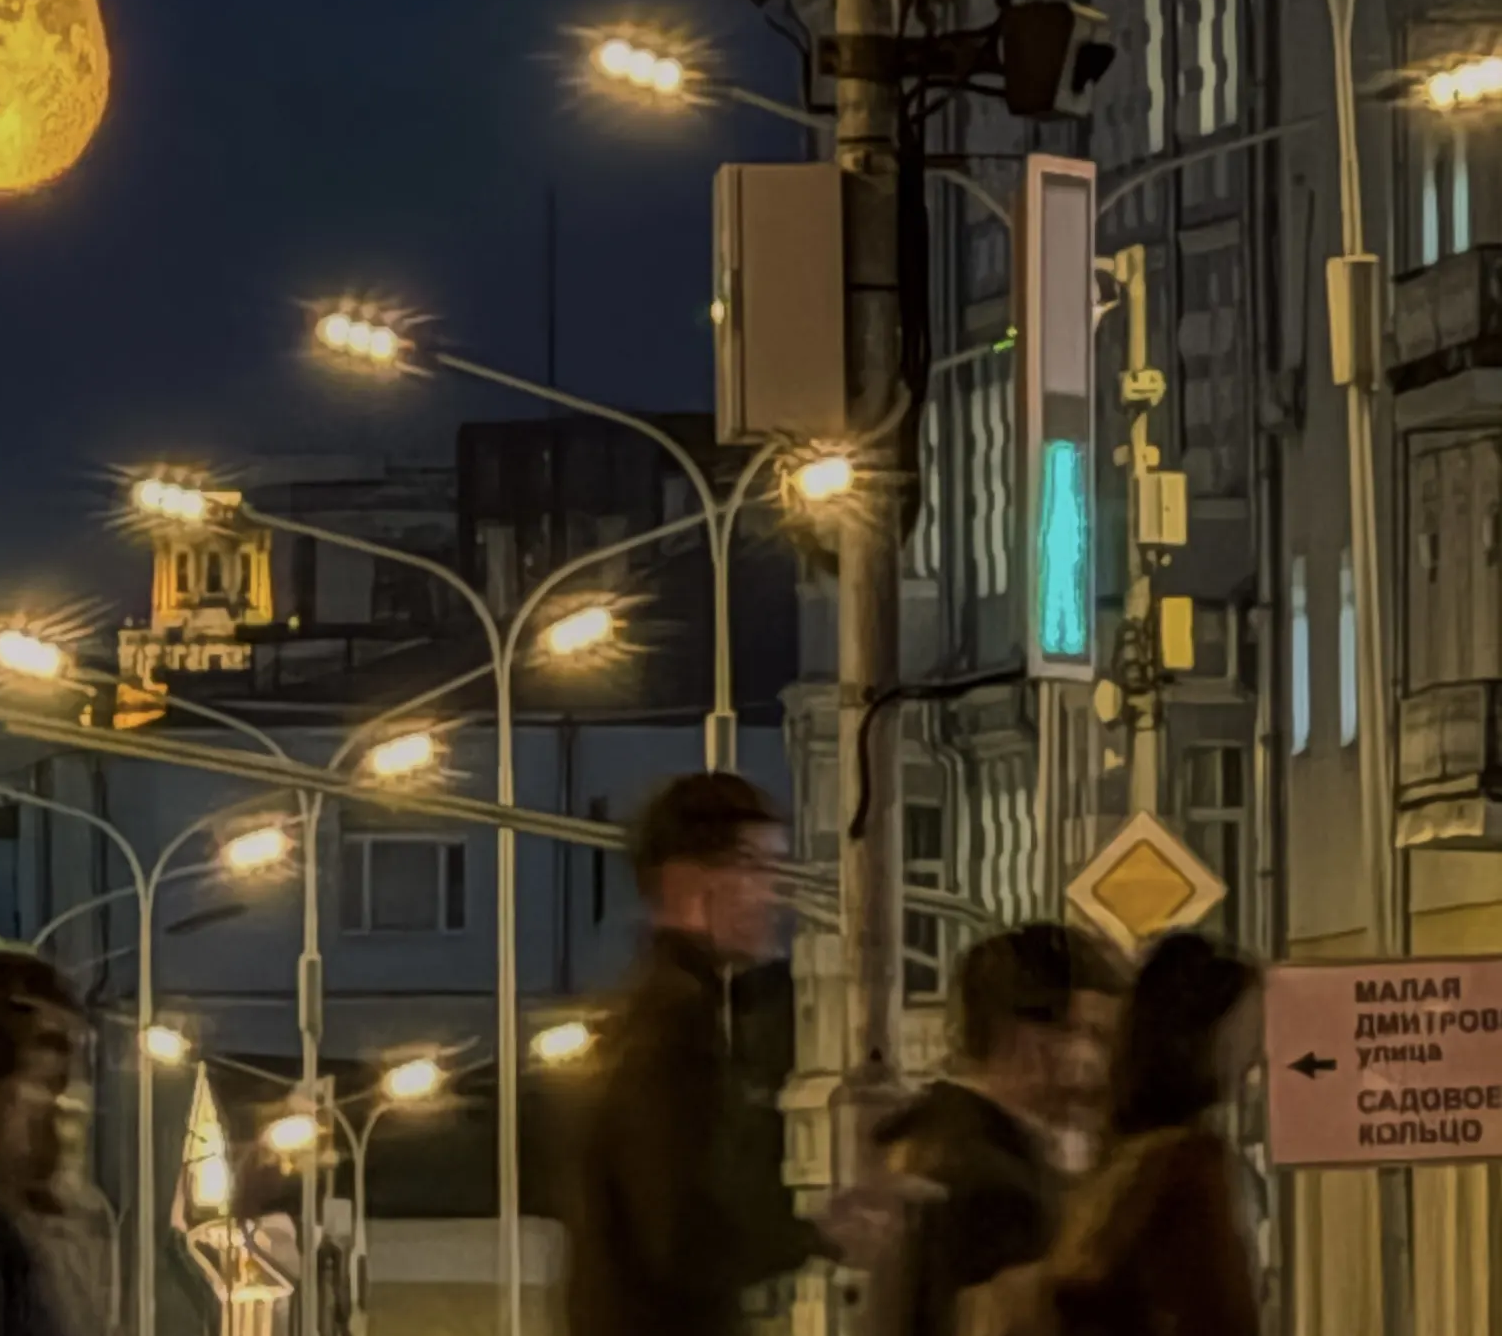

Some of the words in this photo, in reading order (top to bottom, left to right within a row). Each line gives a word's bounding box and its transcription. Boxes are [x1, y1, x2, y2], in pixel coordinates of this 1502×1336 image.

[1355, 977, 1460, 1002] МАЛАЯ
[1354, 1008, 1502, 1040] ДМИТРОВ
[1356, 1043, 1443, 1070] улица
[1357, 1085, 1502, 1115] САДОВОЕ
[1359, 1119, 1483, 1146] КОЛЬЦО
